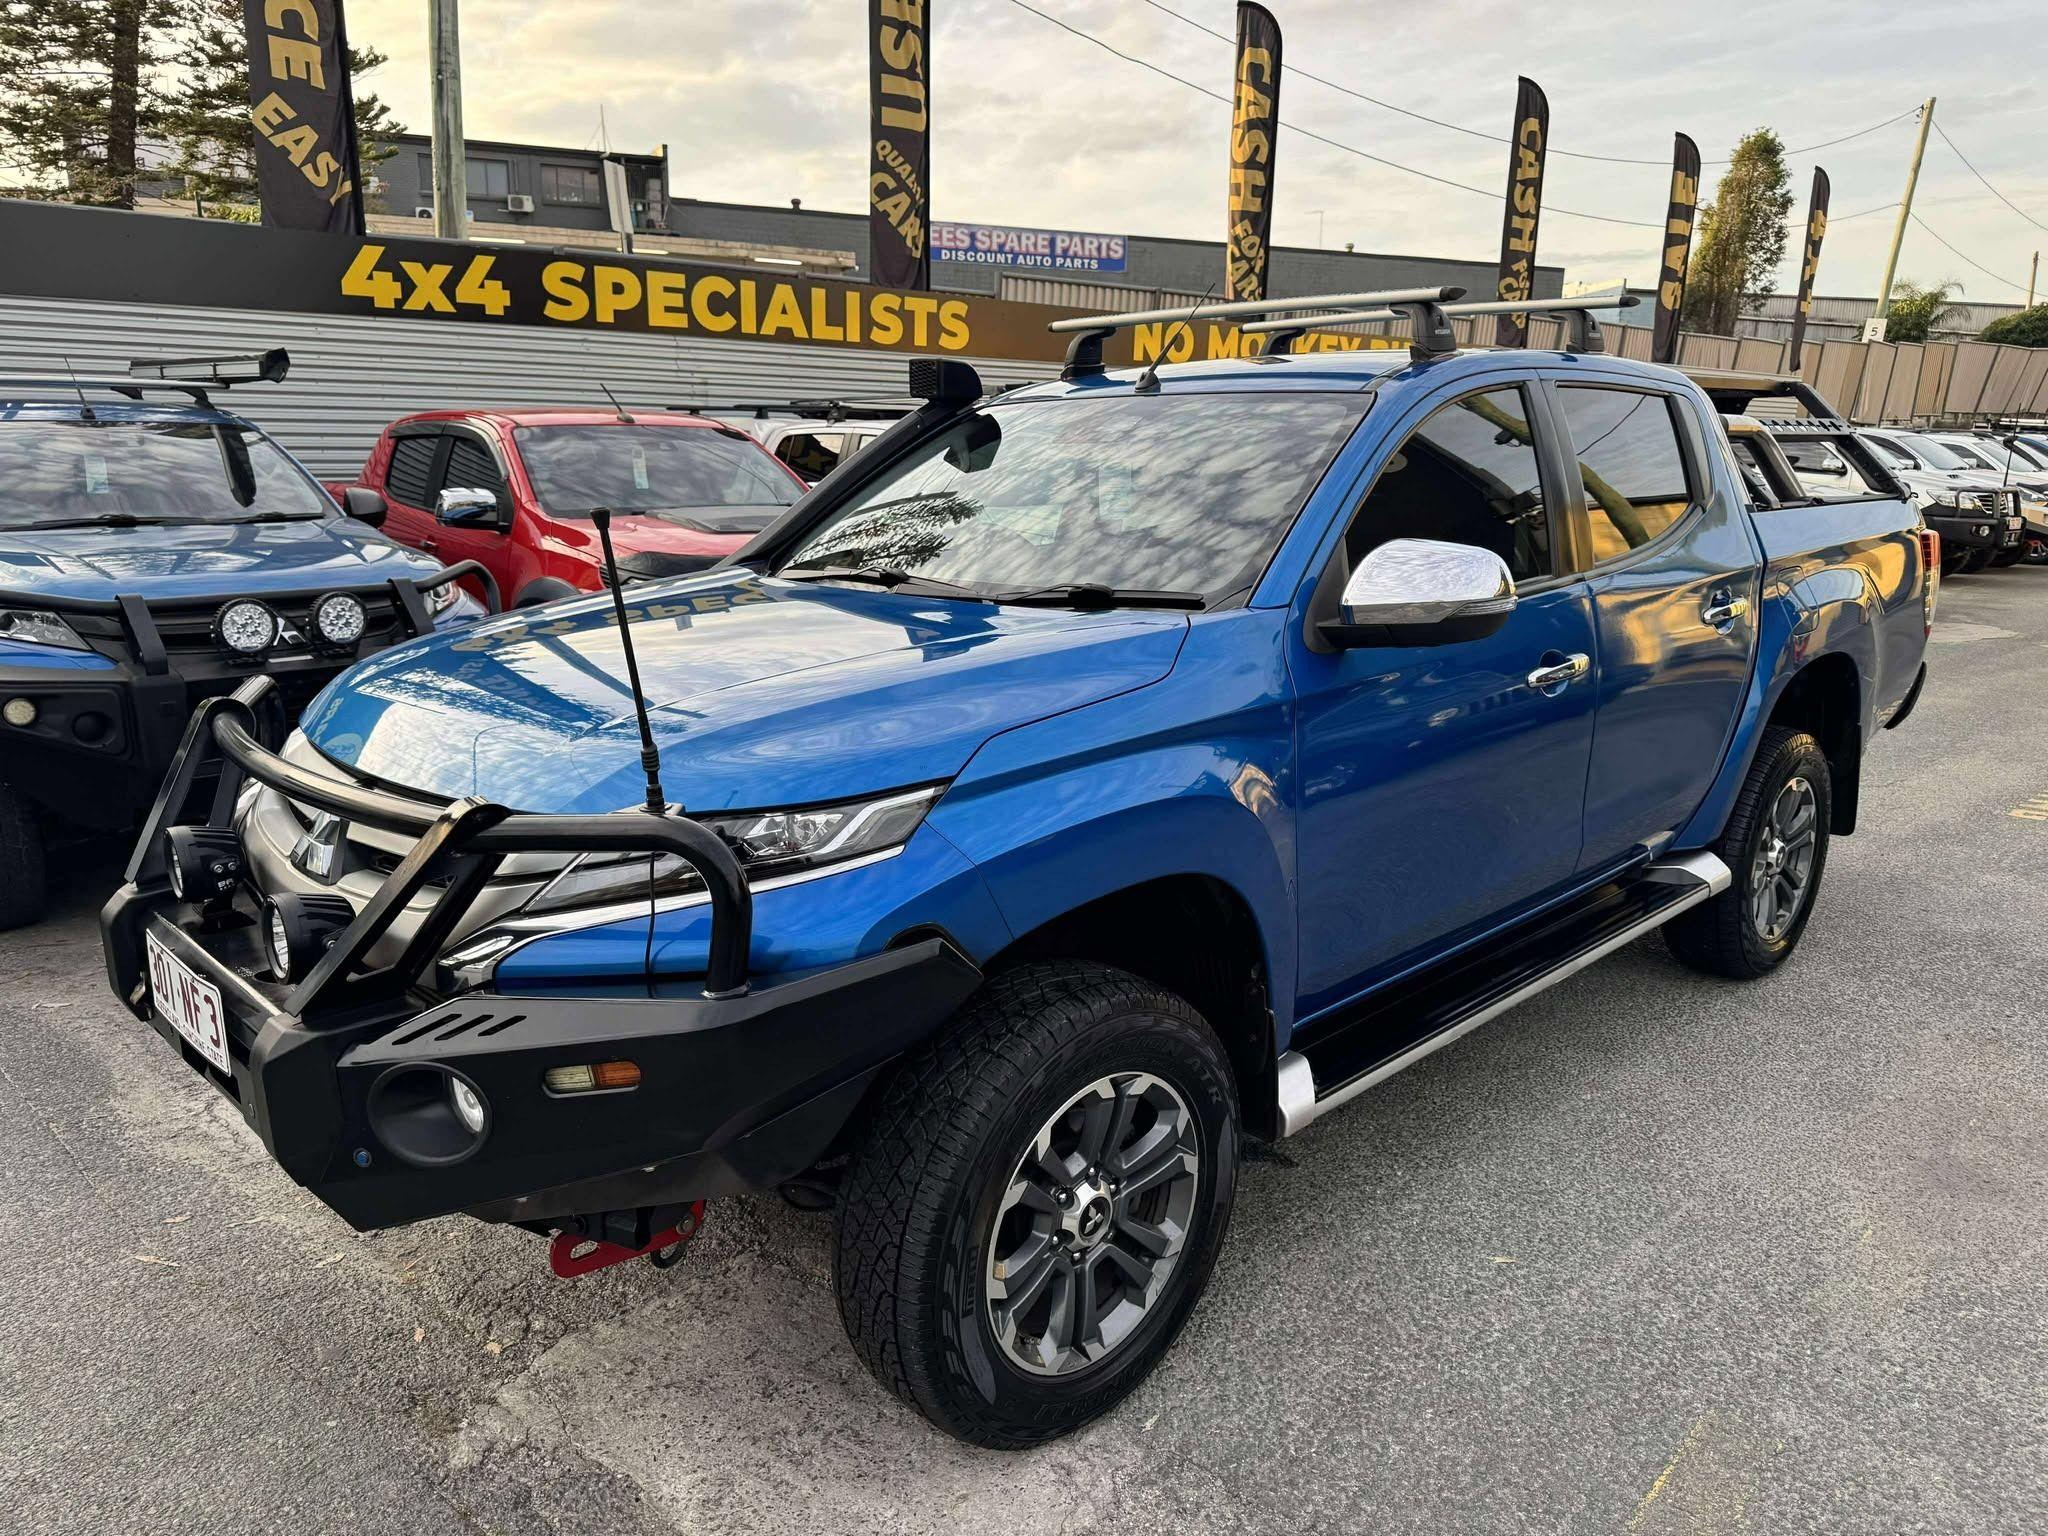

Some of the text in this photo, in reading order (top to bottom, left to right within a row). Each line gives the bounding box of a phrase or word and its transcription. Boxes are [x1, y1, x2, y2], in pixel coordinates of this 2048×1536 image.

[251, 92, 353, 207] EASY
[1230, 47, 1271, 212] CASH
[1508, 117, 1541, 252] CASH
[941, 249, 1099, 270] DISCOUNT AUTO PARTS
[975, 228, 1049, 254] SPARE
[1055, 233, 1124, 260] PARTS
[341, 244, 970, 350] 4x4 SPECIALISTS
[1870, 326, 1879, 337] 5
[1133, 321, 1361, 363] NO MOKEY
